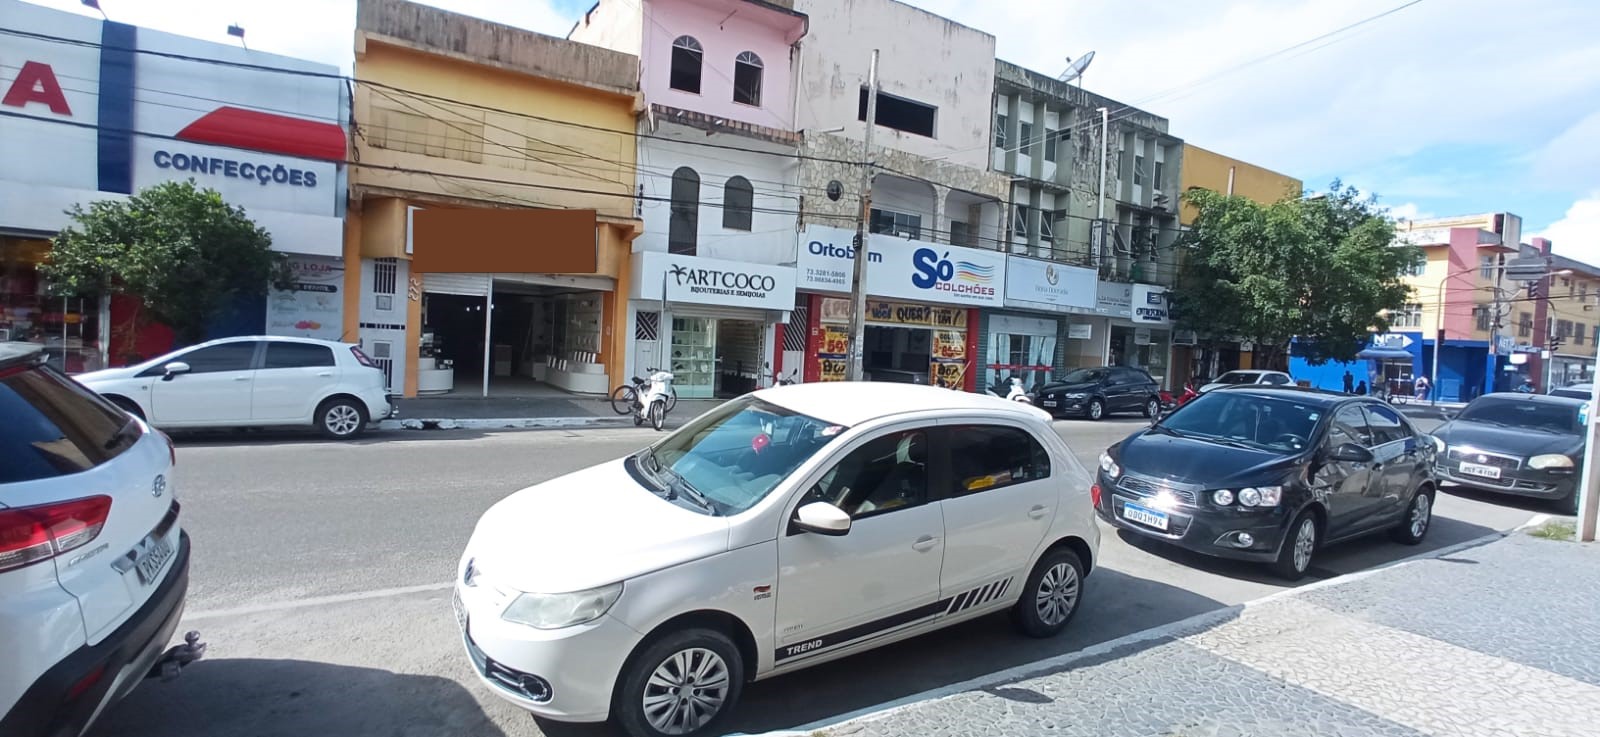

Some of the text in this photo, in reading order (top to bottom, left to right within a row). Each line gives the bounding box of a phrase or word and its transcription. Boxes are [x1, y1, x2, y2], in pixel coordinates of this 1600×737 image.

[153, 150, 318, 188] CONFECÇÕES
[808, 241, 882, 263] Ortobm
[912, 247, 954, 289] Só
[686, 268, 776, 292] ARTCOCO
[690, 286, 730, 296] BIJOUTERIAS
[935, 281, 995, 296] COLCHÕES
[786, 639, 823, 656] TREND
